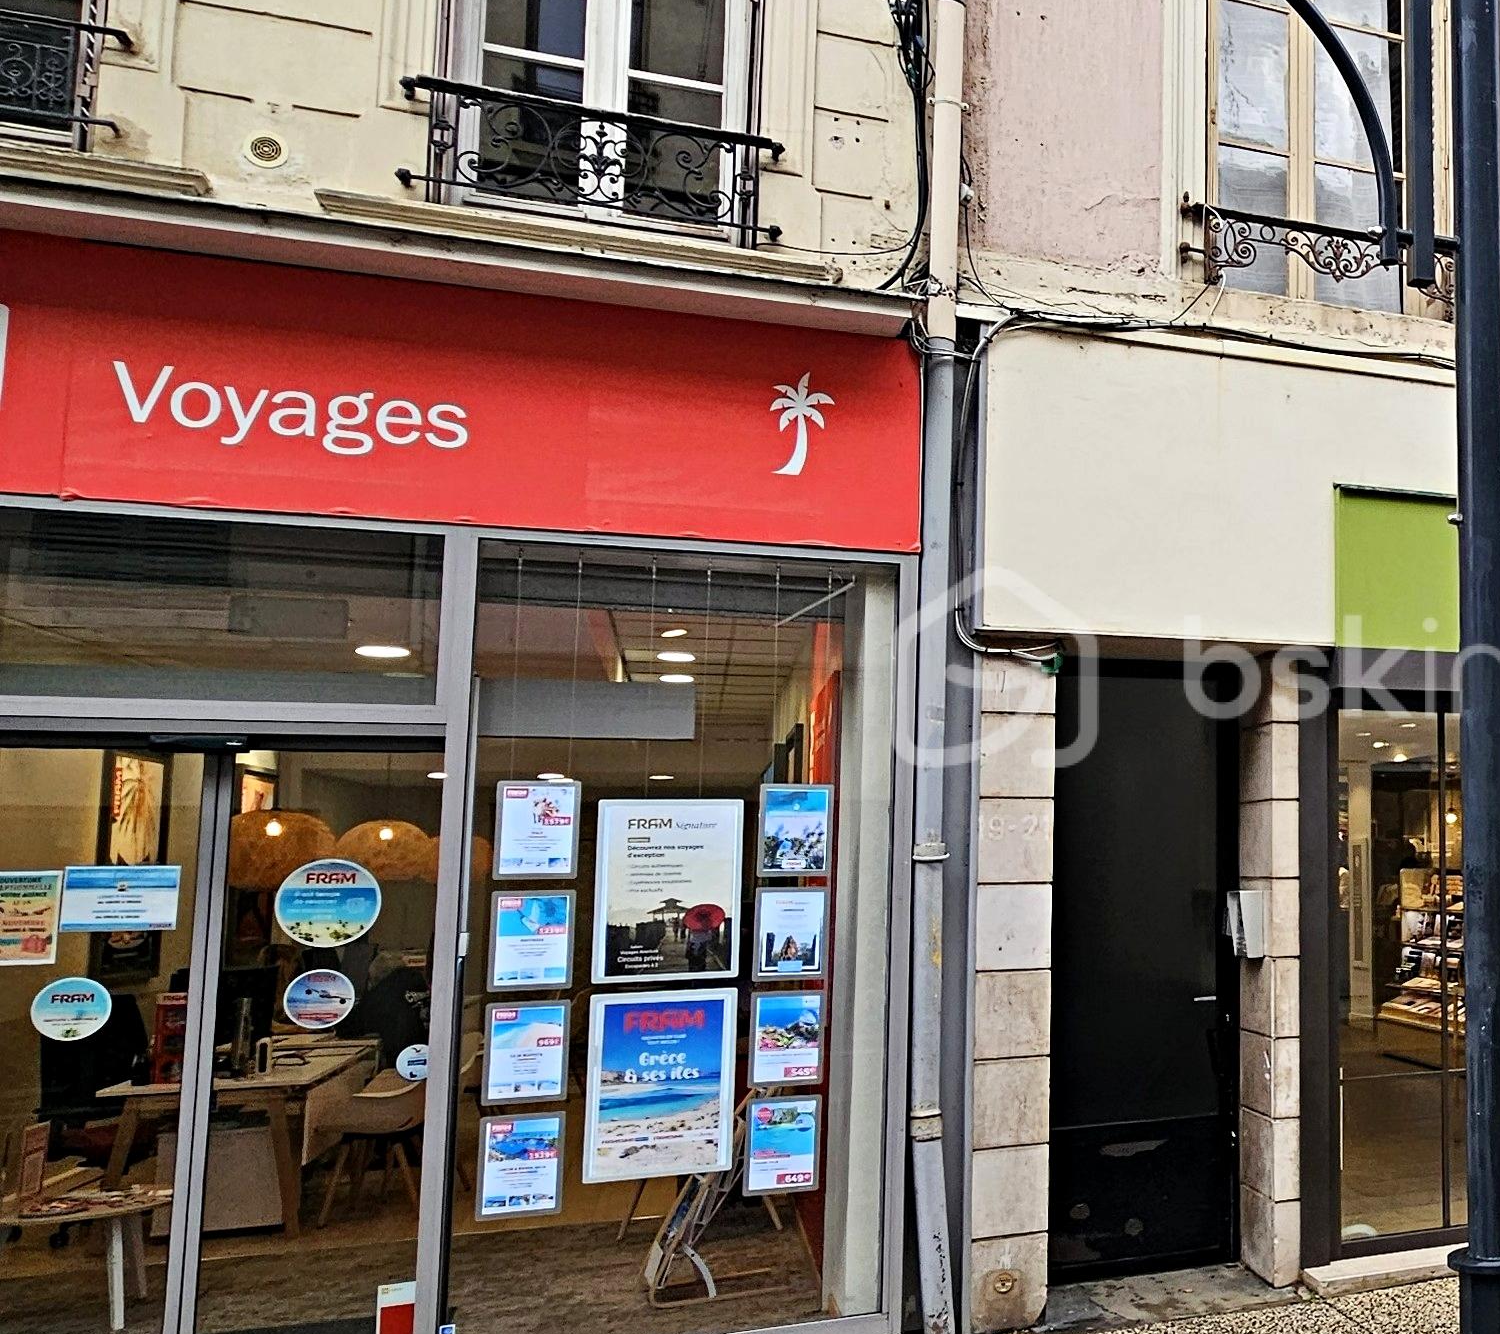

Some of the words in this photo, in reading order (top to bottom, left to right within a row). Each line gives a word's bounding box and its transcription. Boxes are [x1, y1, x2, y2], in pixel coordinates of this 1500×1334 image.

[112, 360, 469, 456] Voyages
[627, 818, 673, 830] FRAM
[305, 872, 356, 885] FRAM
[51, 993, 95, 1004] FRAM
[623, 1009, 705, 1035] FRAM
[638, 1050, 687, 1067] Grèce
[641, 1069, 667, 1082] ses
